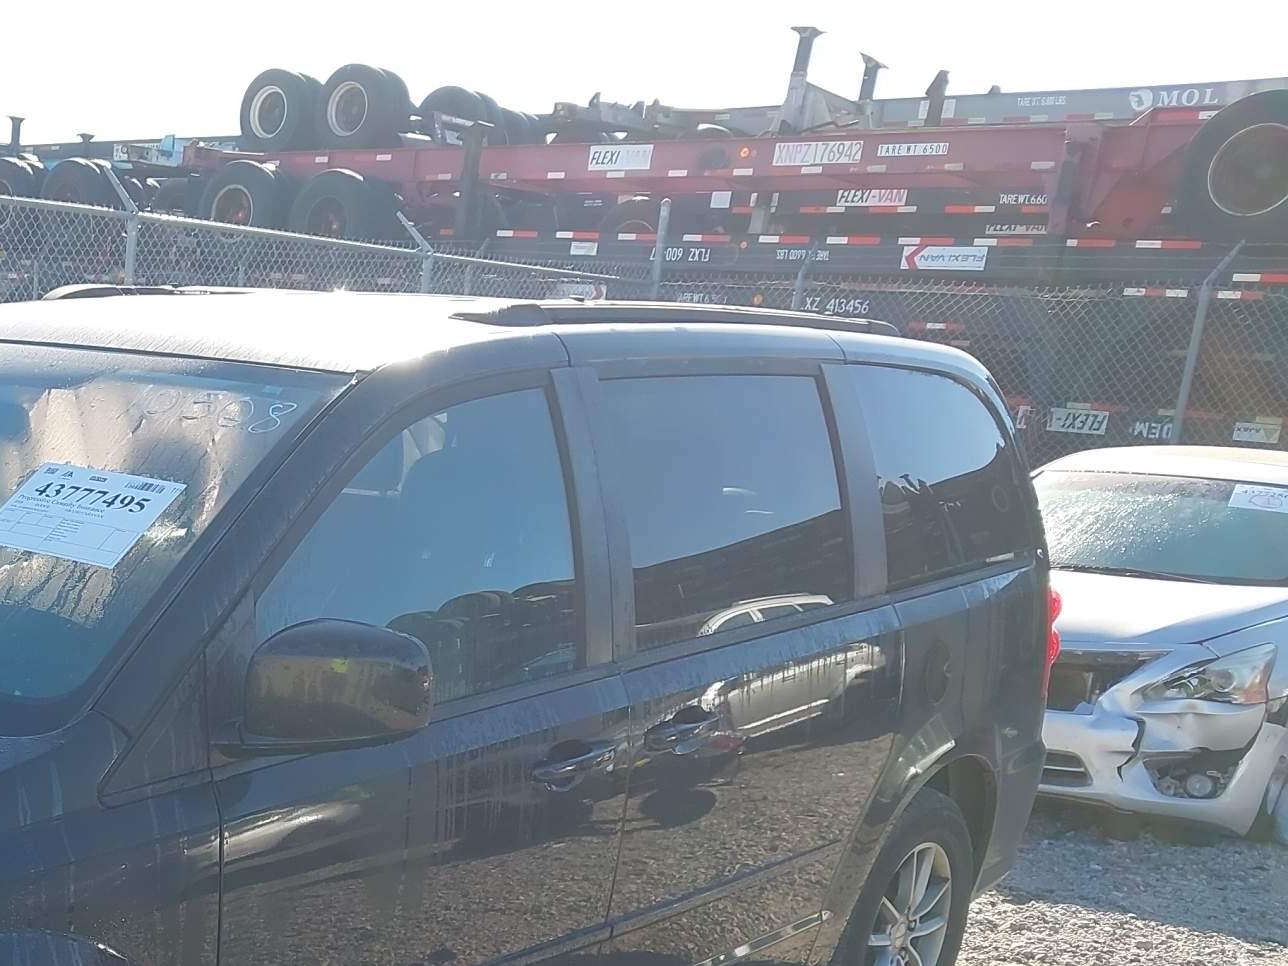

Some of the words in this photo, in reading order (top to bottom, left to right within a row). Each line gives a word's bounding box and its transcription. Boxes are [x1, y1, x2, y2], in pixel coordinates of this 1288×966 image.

[1156, 88, 1219, 107] MOL
[590, 150, 621, 165] FLEXI
[879, 144, 904, 156] TARE
[838, 189, 906, 204] FLEXI-VAN
[688, 247, 711, 262] FLXZ
[34, 481, 152, 513] 43777495
